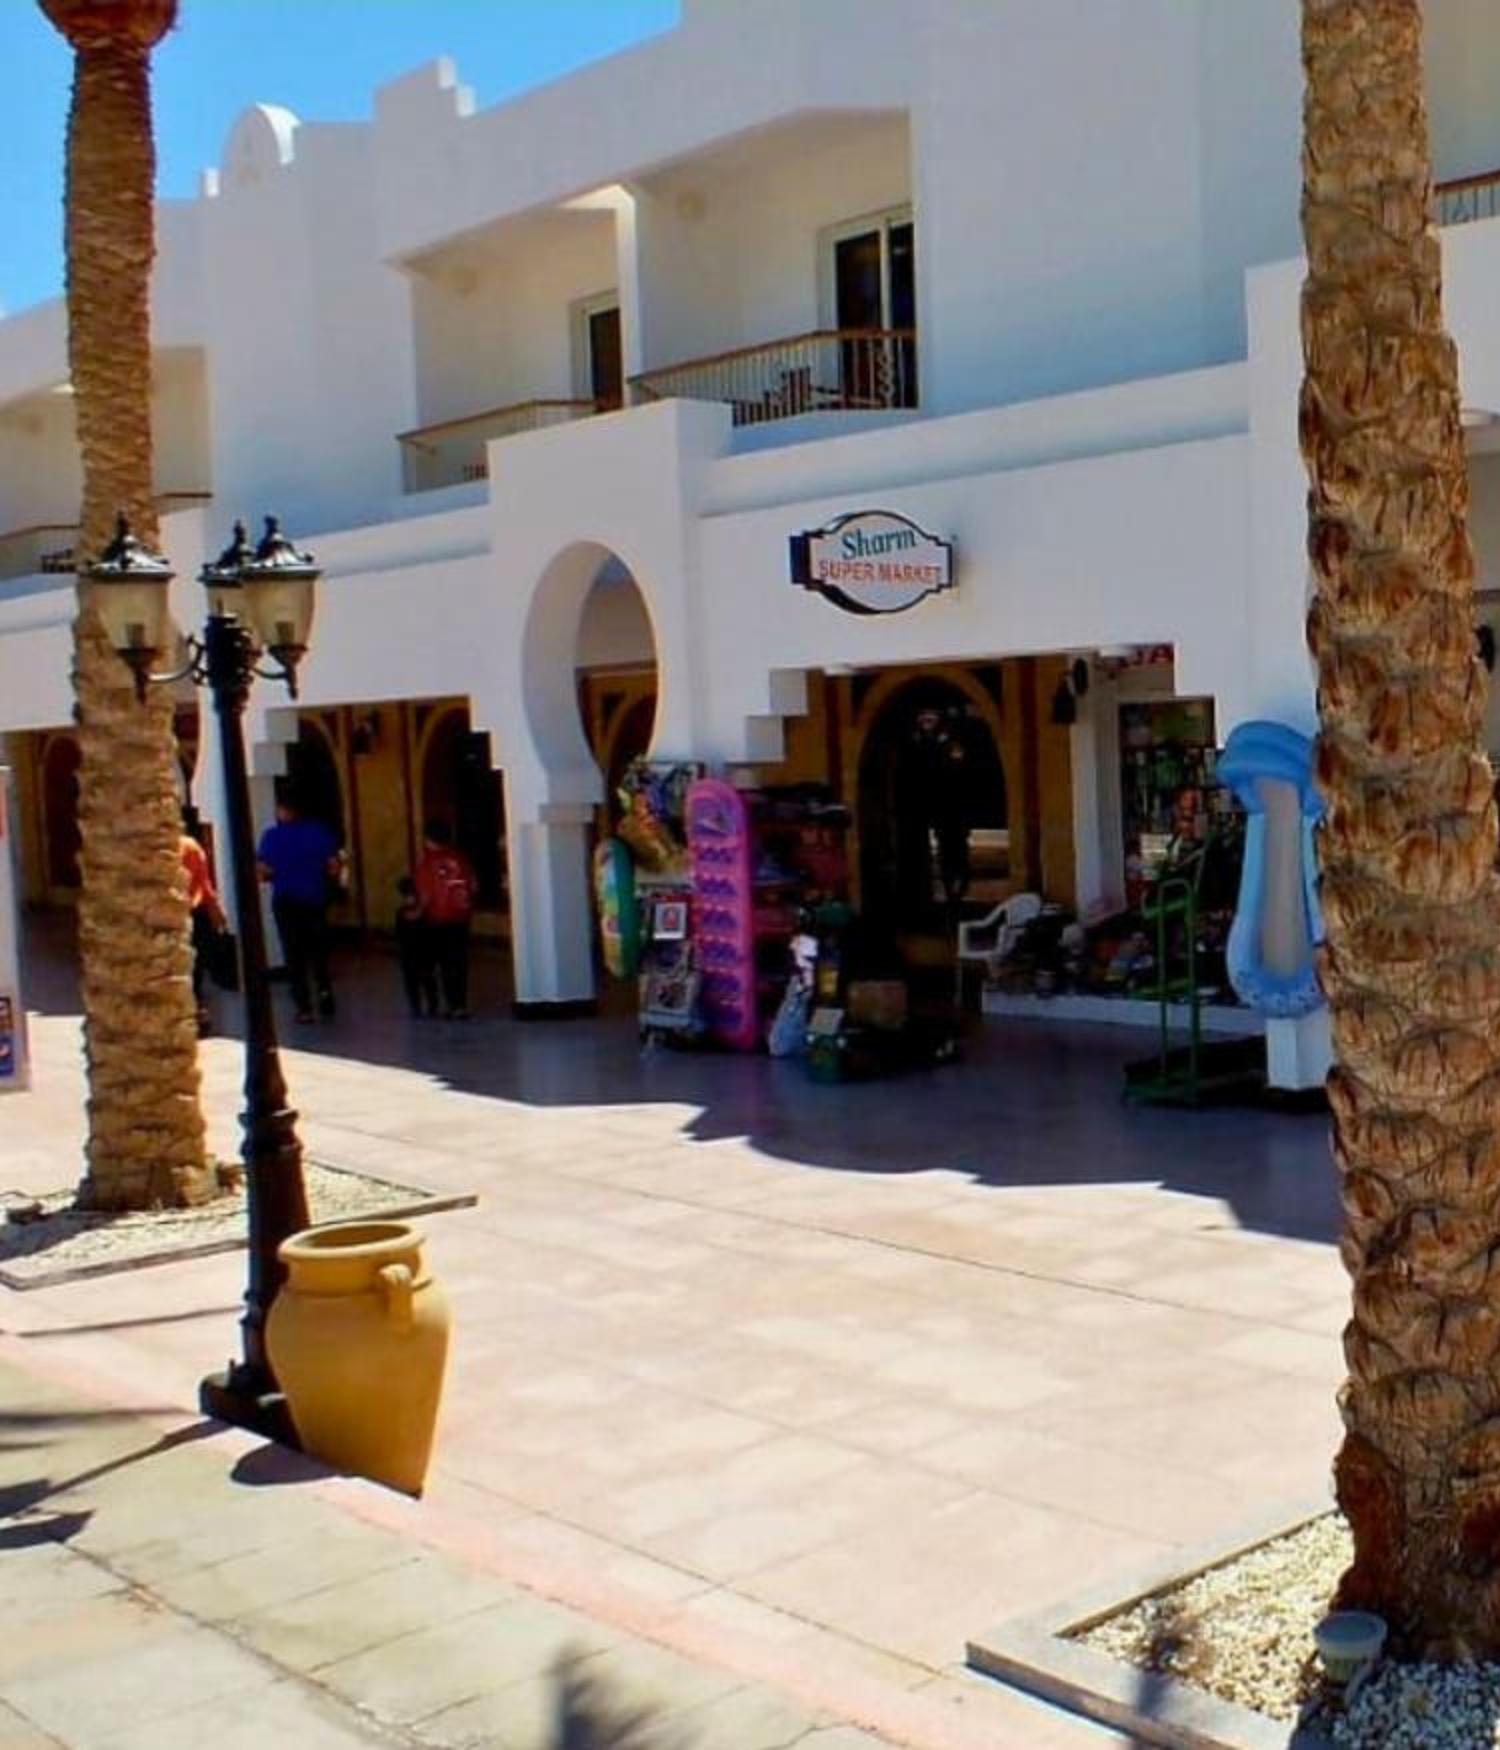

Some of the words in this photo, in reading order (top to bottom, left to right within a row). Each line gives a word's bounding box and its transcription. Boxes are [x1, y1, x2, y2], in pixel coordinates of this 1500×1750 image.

[842, 528, 917, 559] Sharm
[819, 560, 874, 580] SUPER
[879, 562, 941, 584] MARKET
